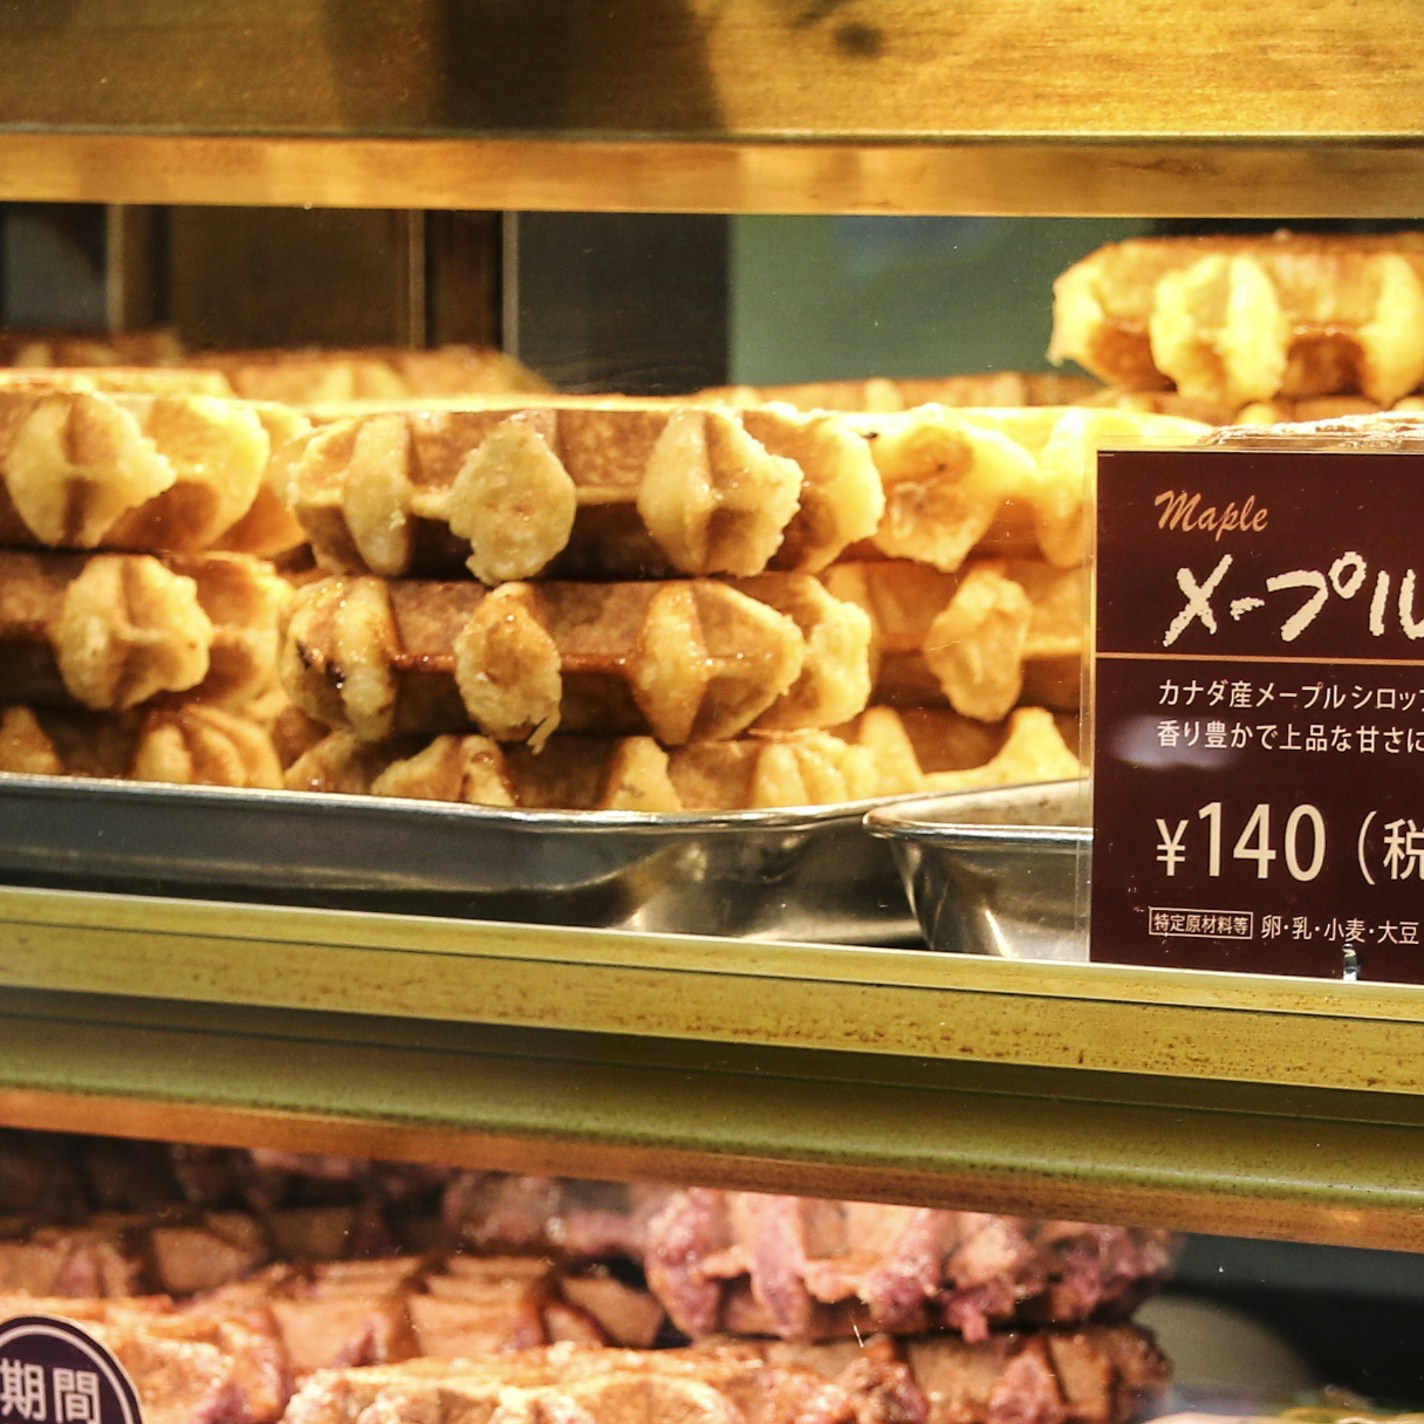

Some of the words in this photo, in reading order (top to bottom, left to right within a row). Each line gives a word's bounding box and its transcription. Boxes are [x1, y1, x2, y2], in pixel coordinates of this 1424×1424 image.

[1154, 489, 1269, 541] Maple
[1155, 801, 1327, 882] ¥140
[1153, 914, 1249, 936] 特定原材料等
